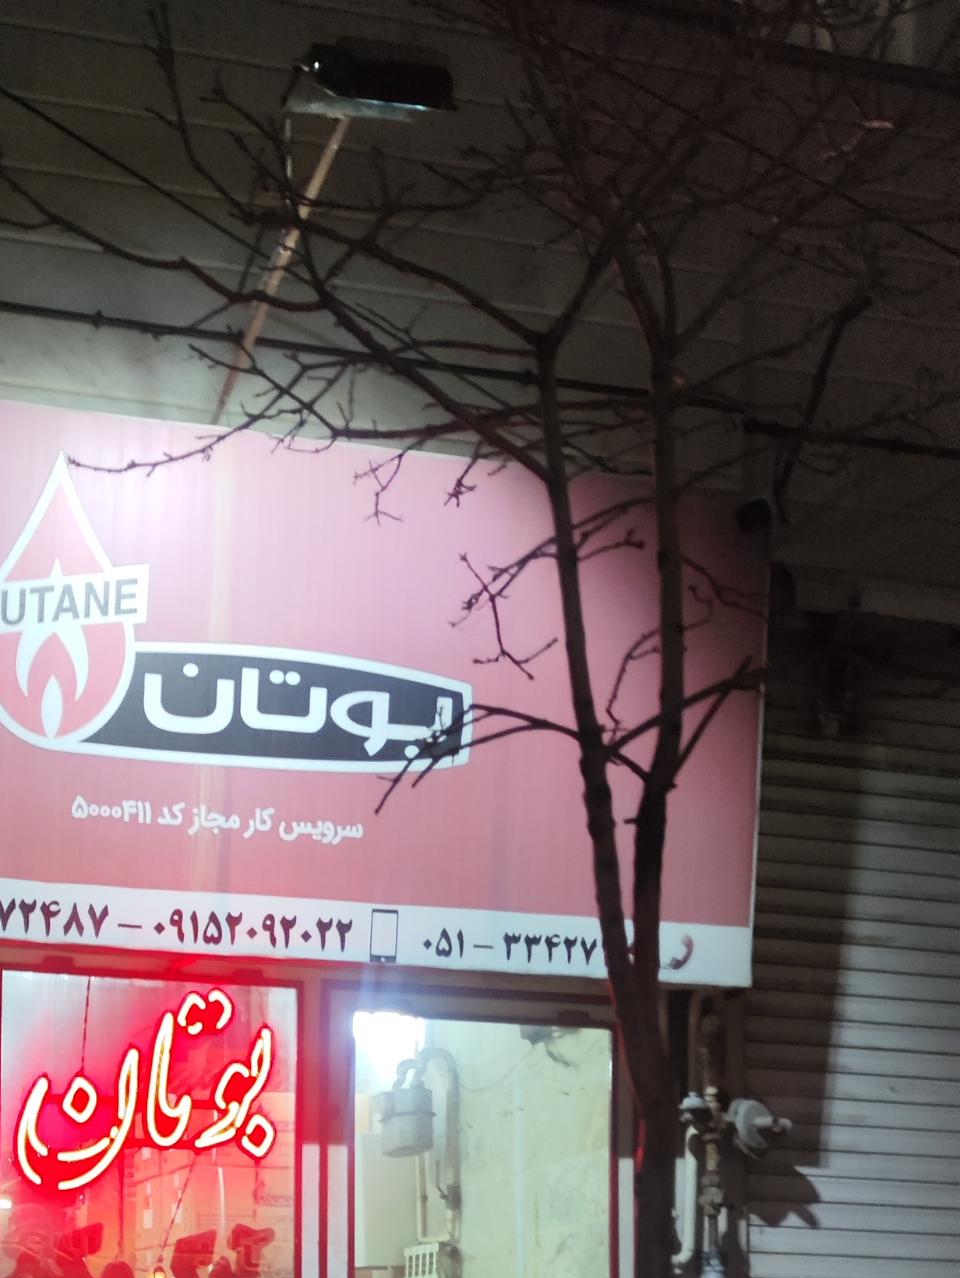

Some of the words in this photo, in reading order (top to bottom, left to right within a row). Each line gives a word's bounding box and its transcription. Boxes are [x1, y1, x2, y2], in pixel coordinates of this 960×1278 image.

[143, 662, 455, 758] بوتان
[71, 794, 153, 825] ۵۰۰۰۴۱۱
[157, 802, 184, 827] کد
[188, 803, 241, 835] مجاز
[243, 809, 275, 839] کار
[278, 816, 364, 845] سرویس
[153, 907, 354, 953] ۰۹۱۵۲۰۹۲۰۲۲
[503, 932, 599, 966] ۳۳۴۲۷
[15, 988, 276, 1191] بوتان
